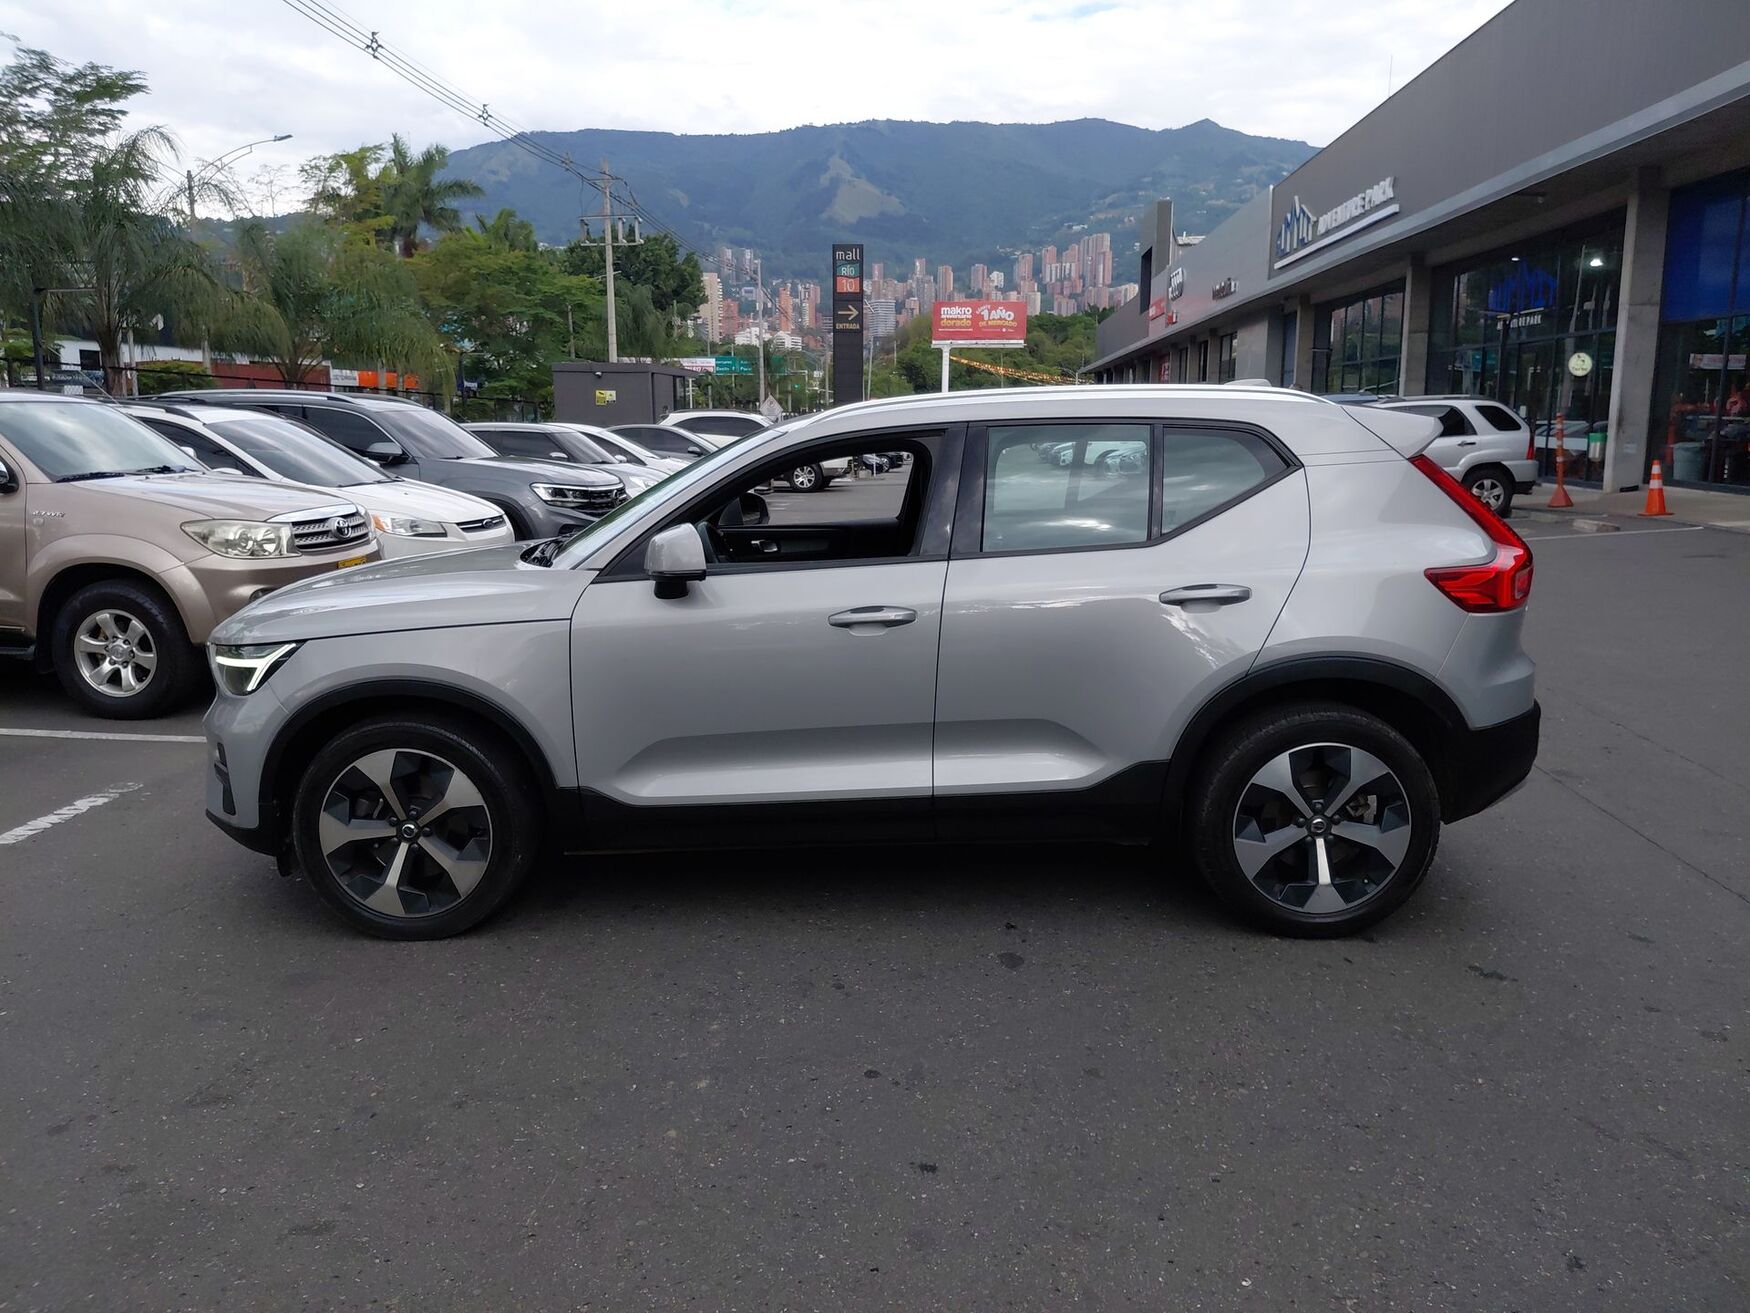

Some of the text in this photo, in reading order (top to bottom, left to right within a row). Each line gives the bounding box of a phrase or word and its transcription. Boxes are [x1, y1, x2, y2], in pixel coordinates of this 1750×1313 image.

[1365, 177, 1394, 211] PARK
[836, 248, 860, 260] mall
[841, 265, 855, 275] RÍO
[841, 279, 855, 291] 10
[940, 306, 972, 315] makro
[989, 306, 1014, 320] AÑO
[940, 318, 972, 326] dorado
[1526, 315, 1541, 326] PARK
